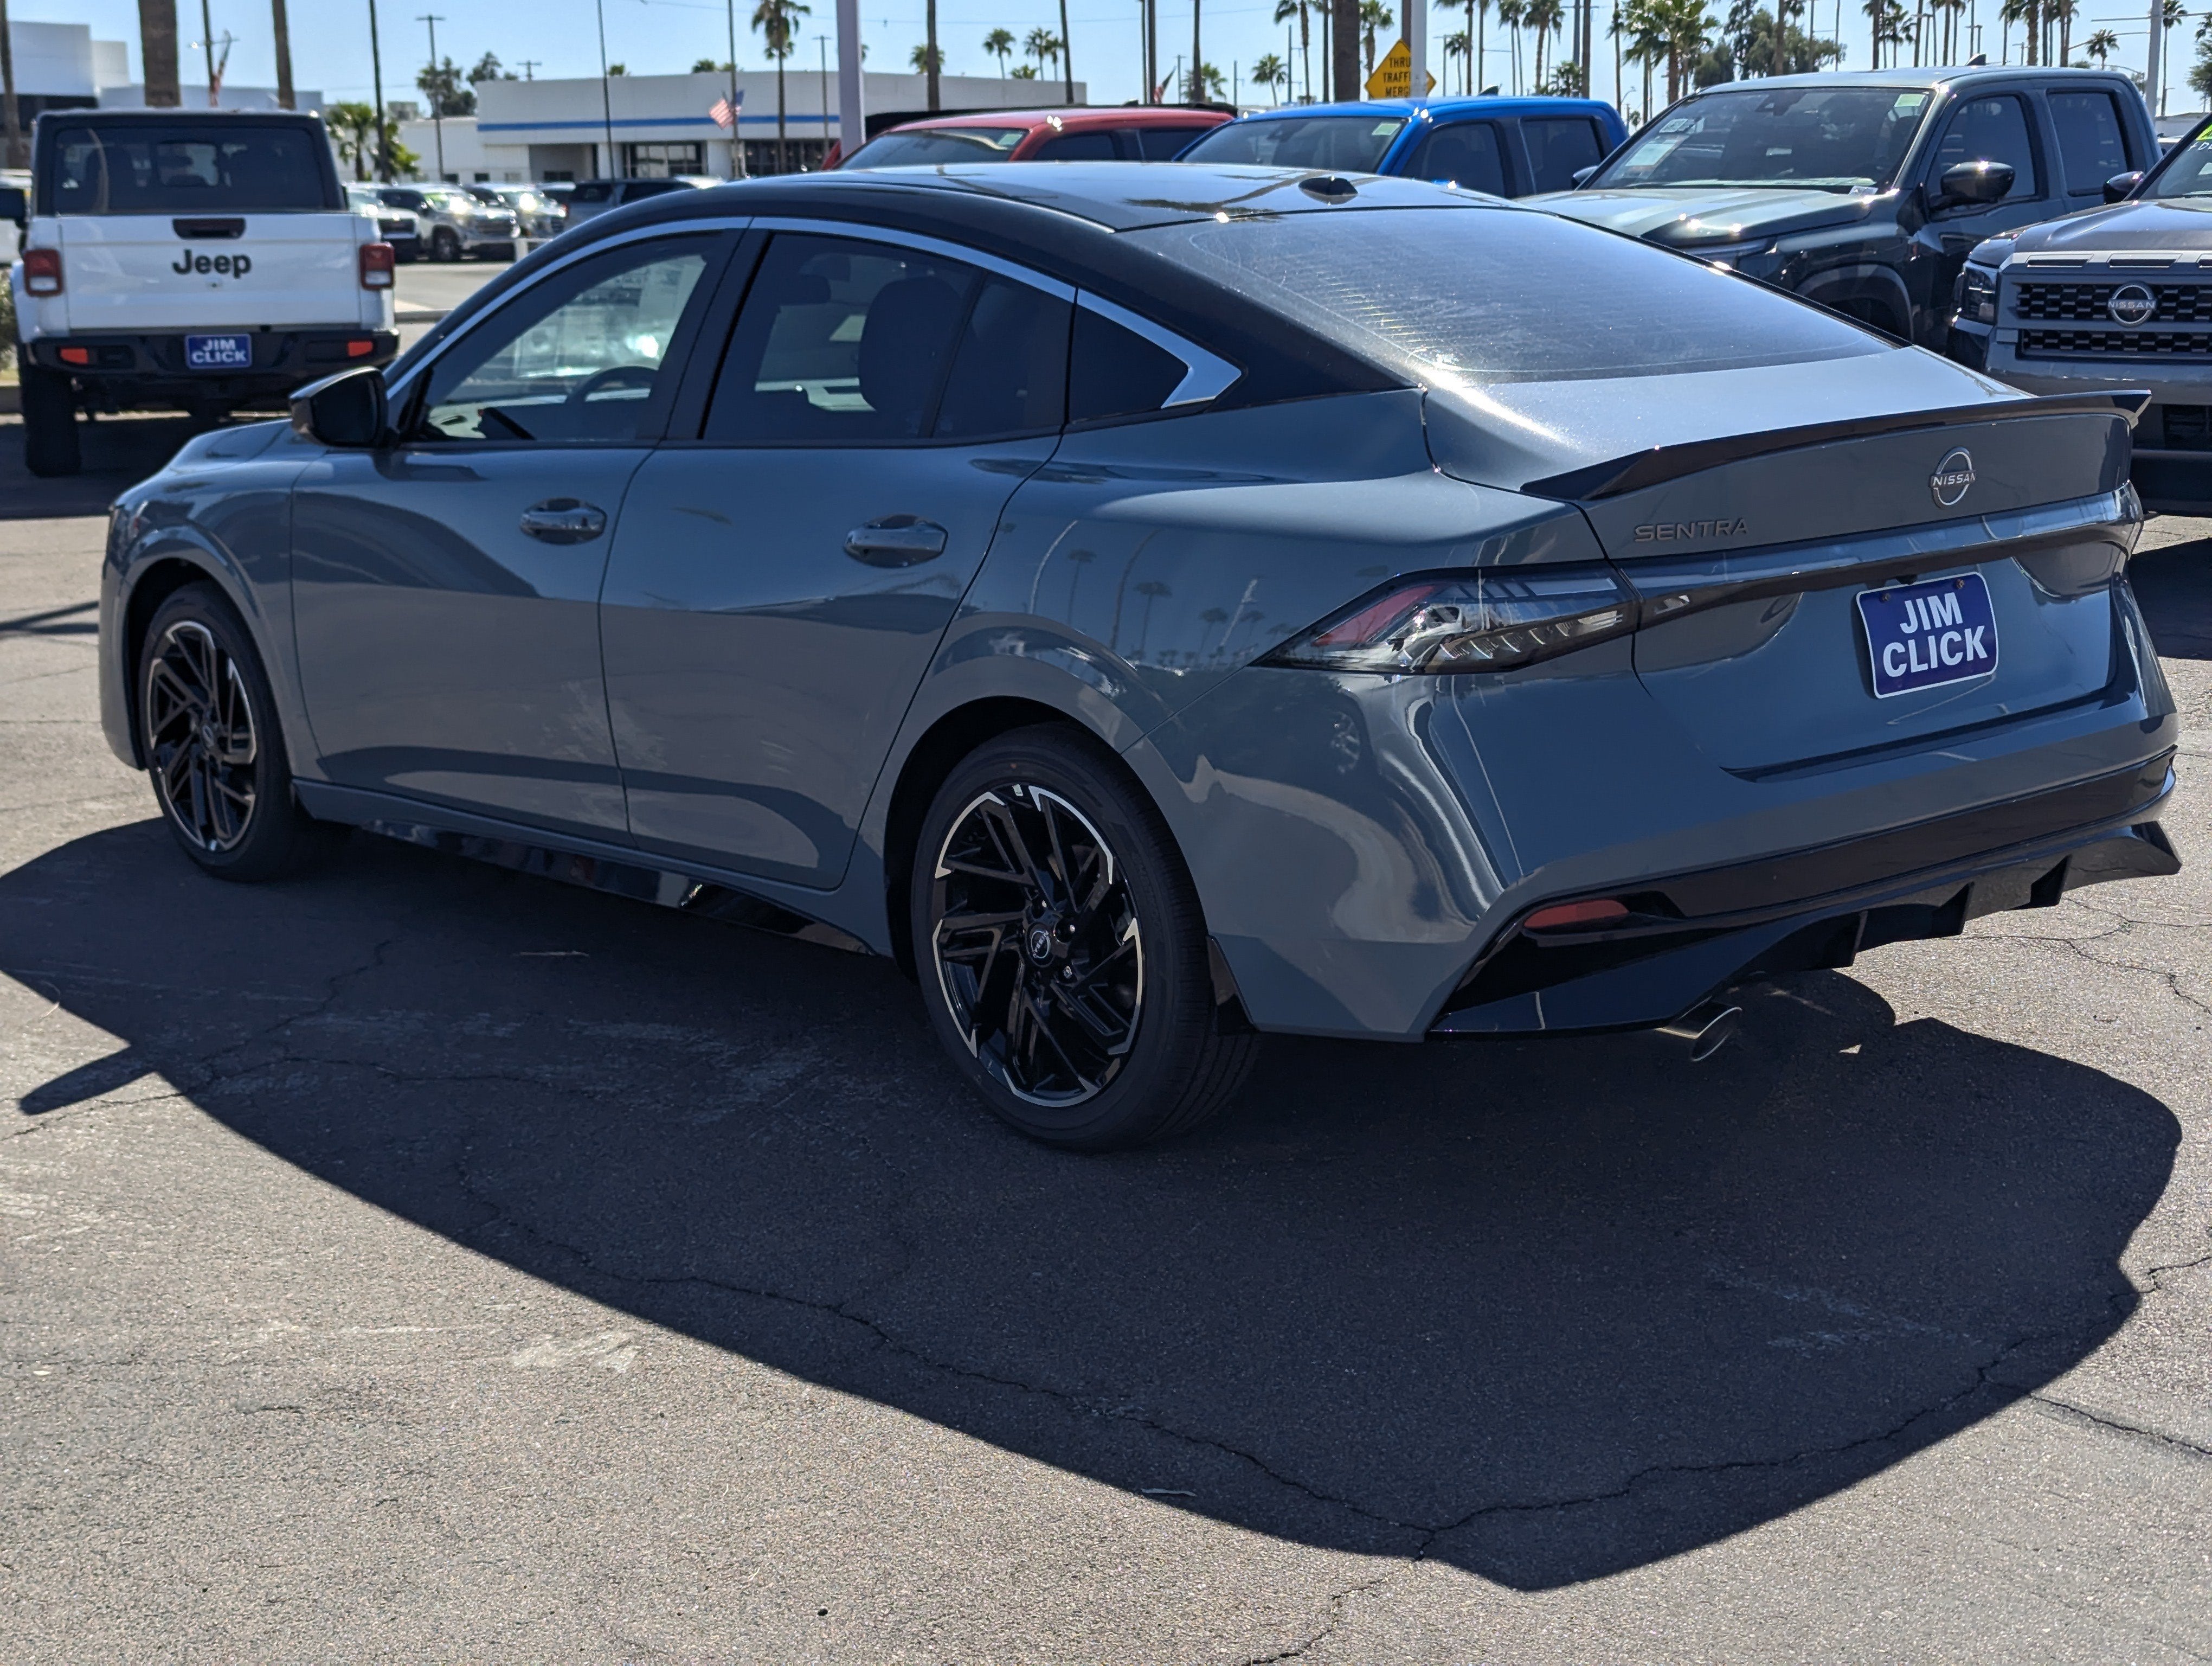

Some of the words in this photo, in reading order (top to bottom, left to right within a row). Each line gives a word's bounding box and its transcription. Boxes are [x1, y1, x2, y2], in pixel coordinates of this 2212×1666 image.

[1389, 57, 1411, 68] THRU
[1383, 71, 1411, 84] TRAFFI
[1385, 86, 1411, 97] MERG
[172, 249, 251, 279] Jeep
[202, 338, 236, 351] JIM
[192, 350, 247, 363] CLICK
[1933, 472, 1976, 486] NISSAN
[1634, 517, 1748, 542] SENTRA
[1900, 592, 1963, 634] JIM
[1883, 625, 1988, 677] CLICK
